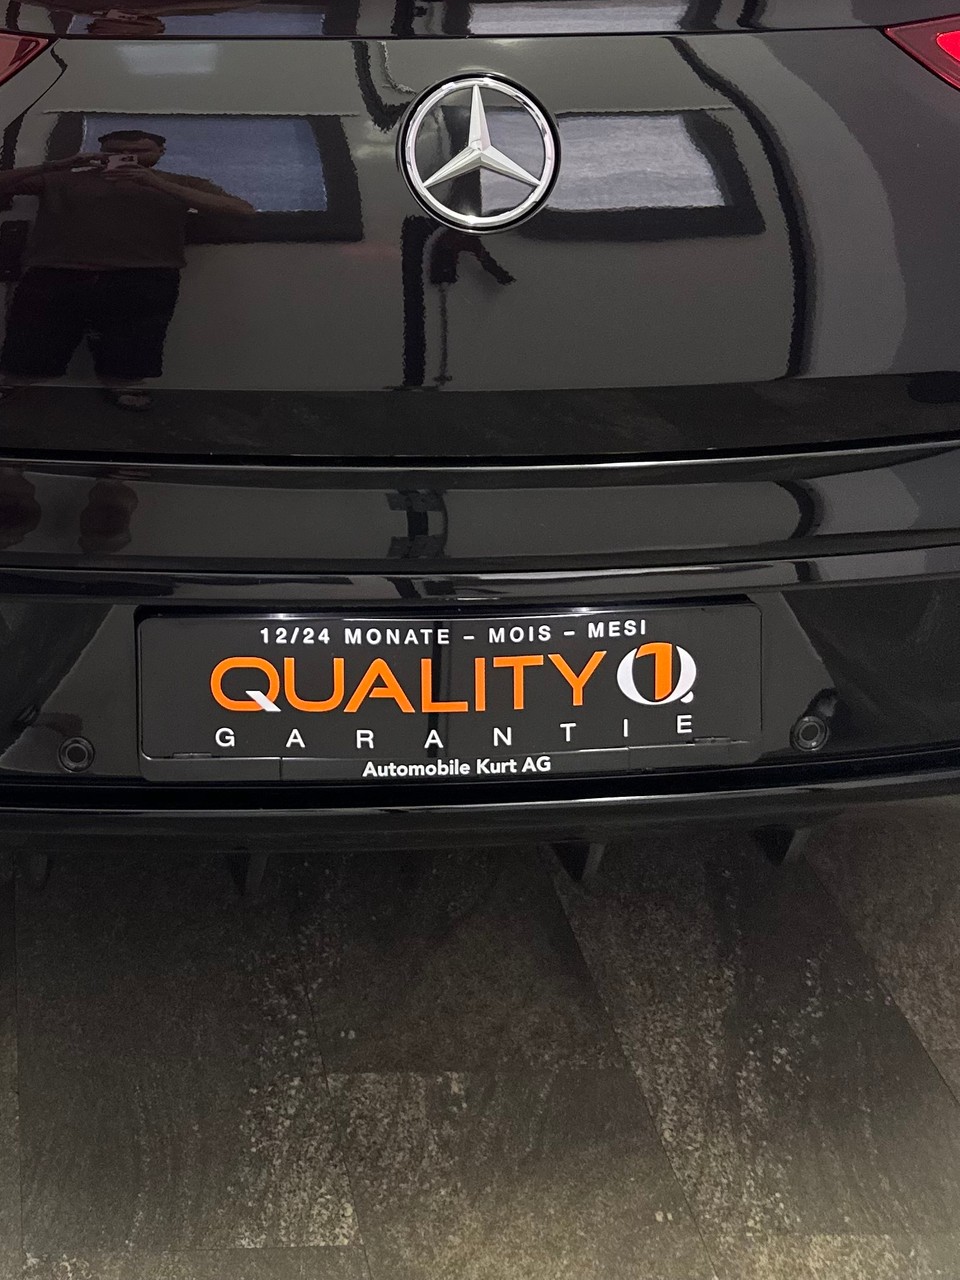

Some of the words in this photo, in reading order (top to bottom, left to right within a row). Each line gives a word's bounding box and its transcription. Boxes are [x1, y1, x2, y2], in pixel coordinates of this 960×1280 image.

[259, 626, 331, 645] 12/24
[343, 627, 451, 646] MONATE
[488, 624, 552, 644] MOIS
[587, 618, 647, 639] MESI
[209, 650, 608, 714] QUALITY
[214, 713, 693, 750] GARANTIE
[361, 758, 471, 778] Automobile
[475, 751, 518, 775] Kurt
[521, 746, 552, 773] AG
